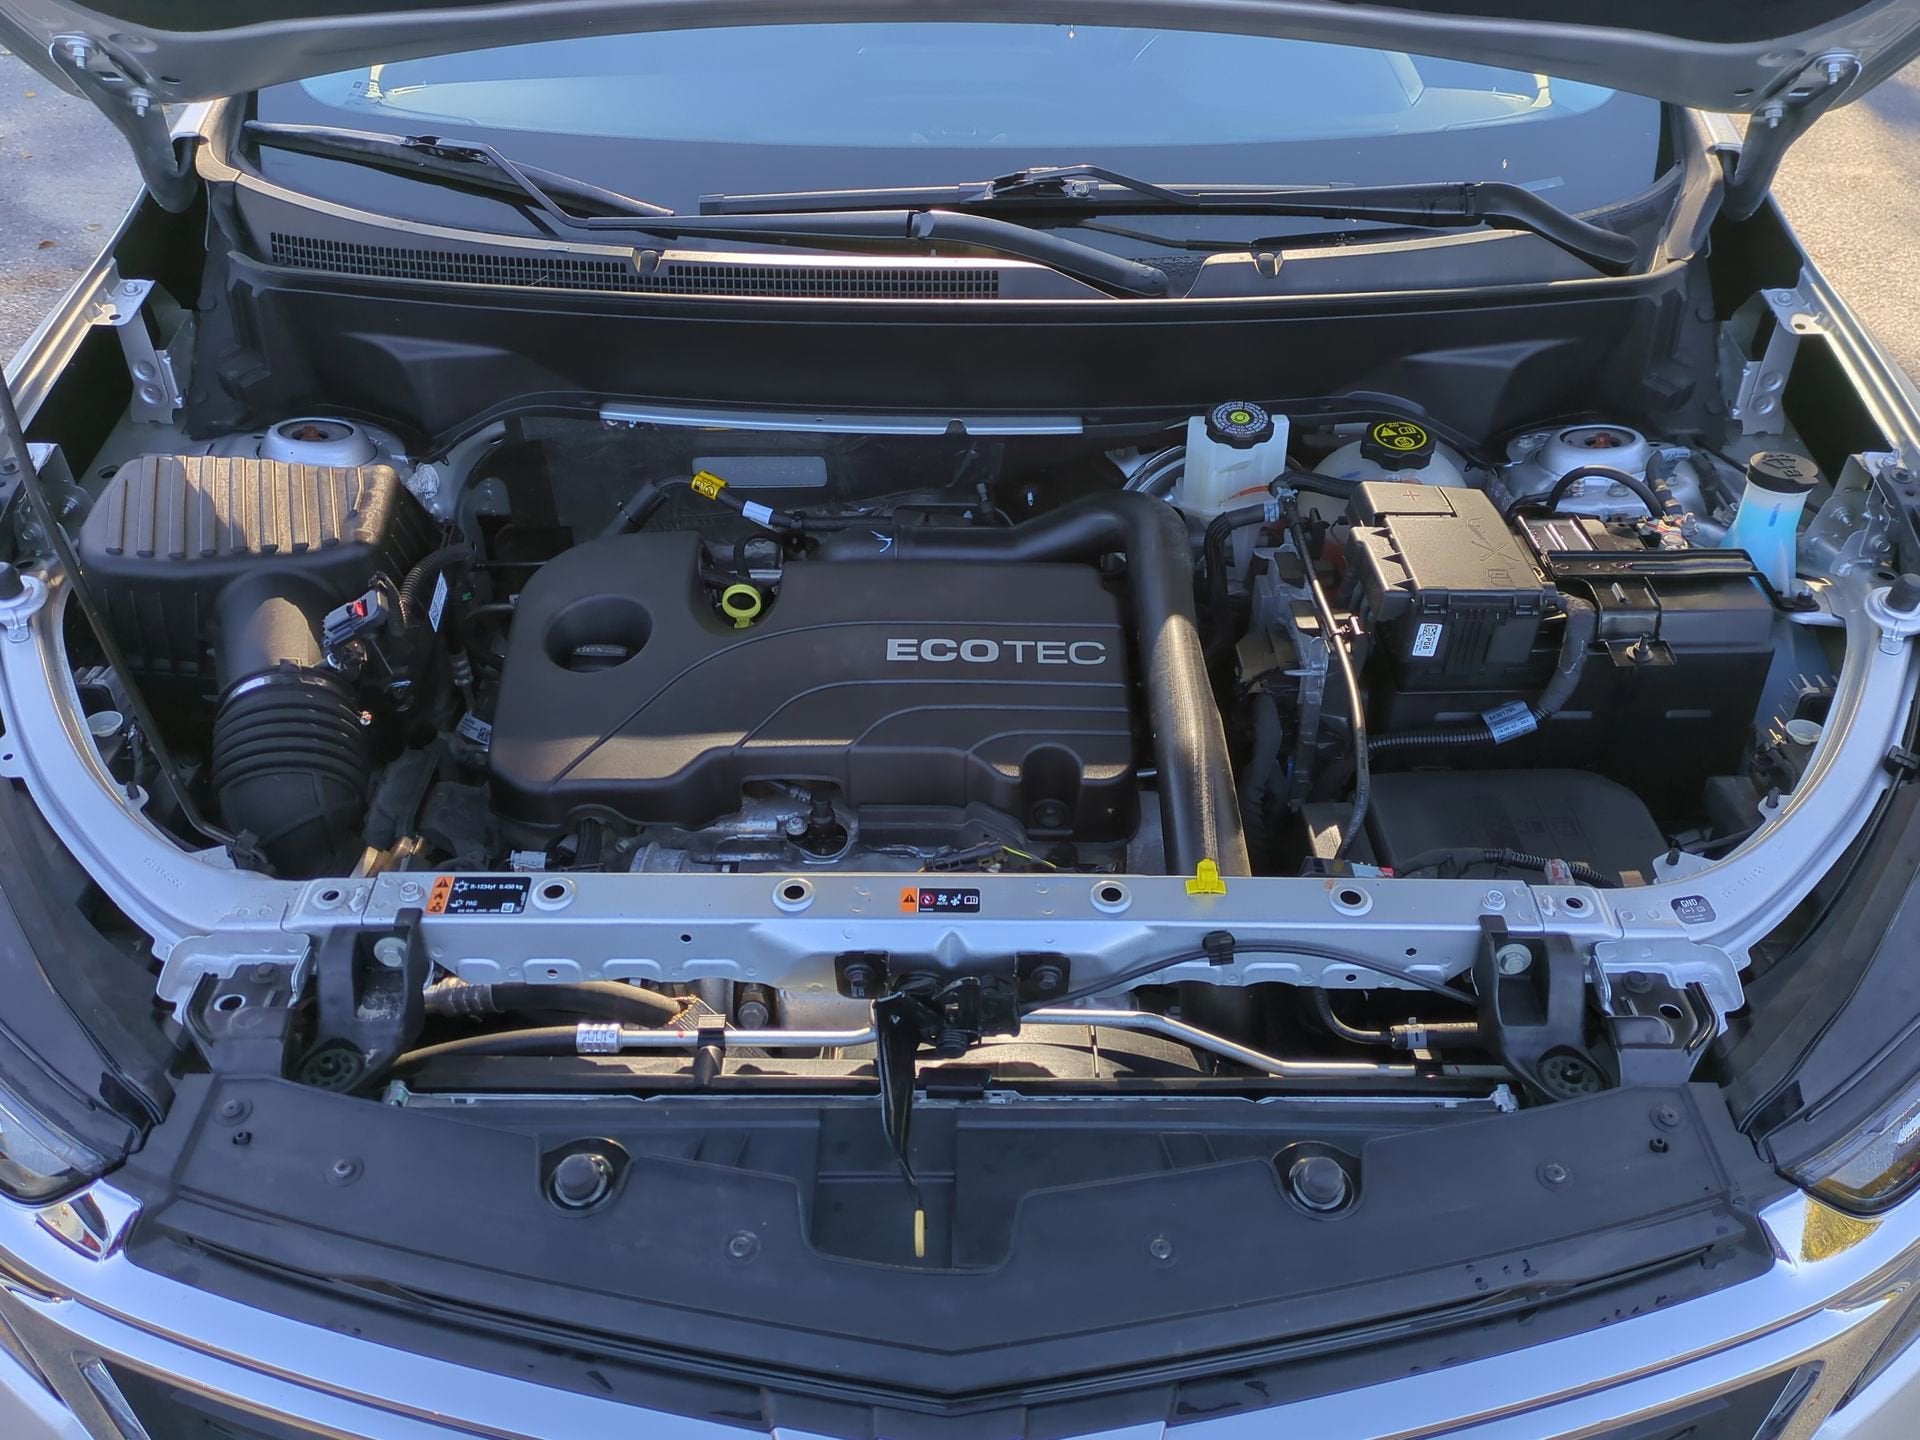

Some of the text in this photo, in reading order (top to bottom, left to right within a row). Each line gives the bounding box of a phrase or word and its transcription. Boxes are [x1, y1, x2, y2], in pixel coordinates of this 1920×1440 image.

[886, 638, 1106, 665] ECOTEC
[470, 883, 496, 891] R-1234yf
[1680, 898, 1698, 908] GND
